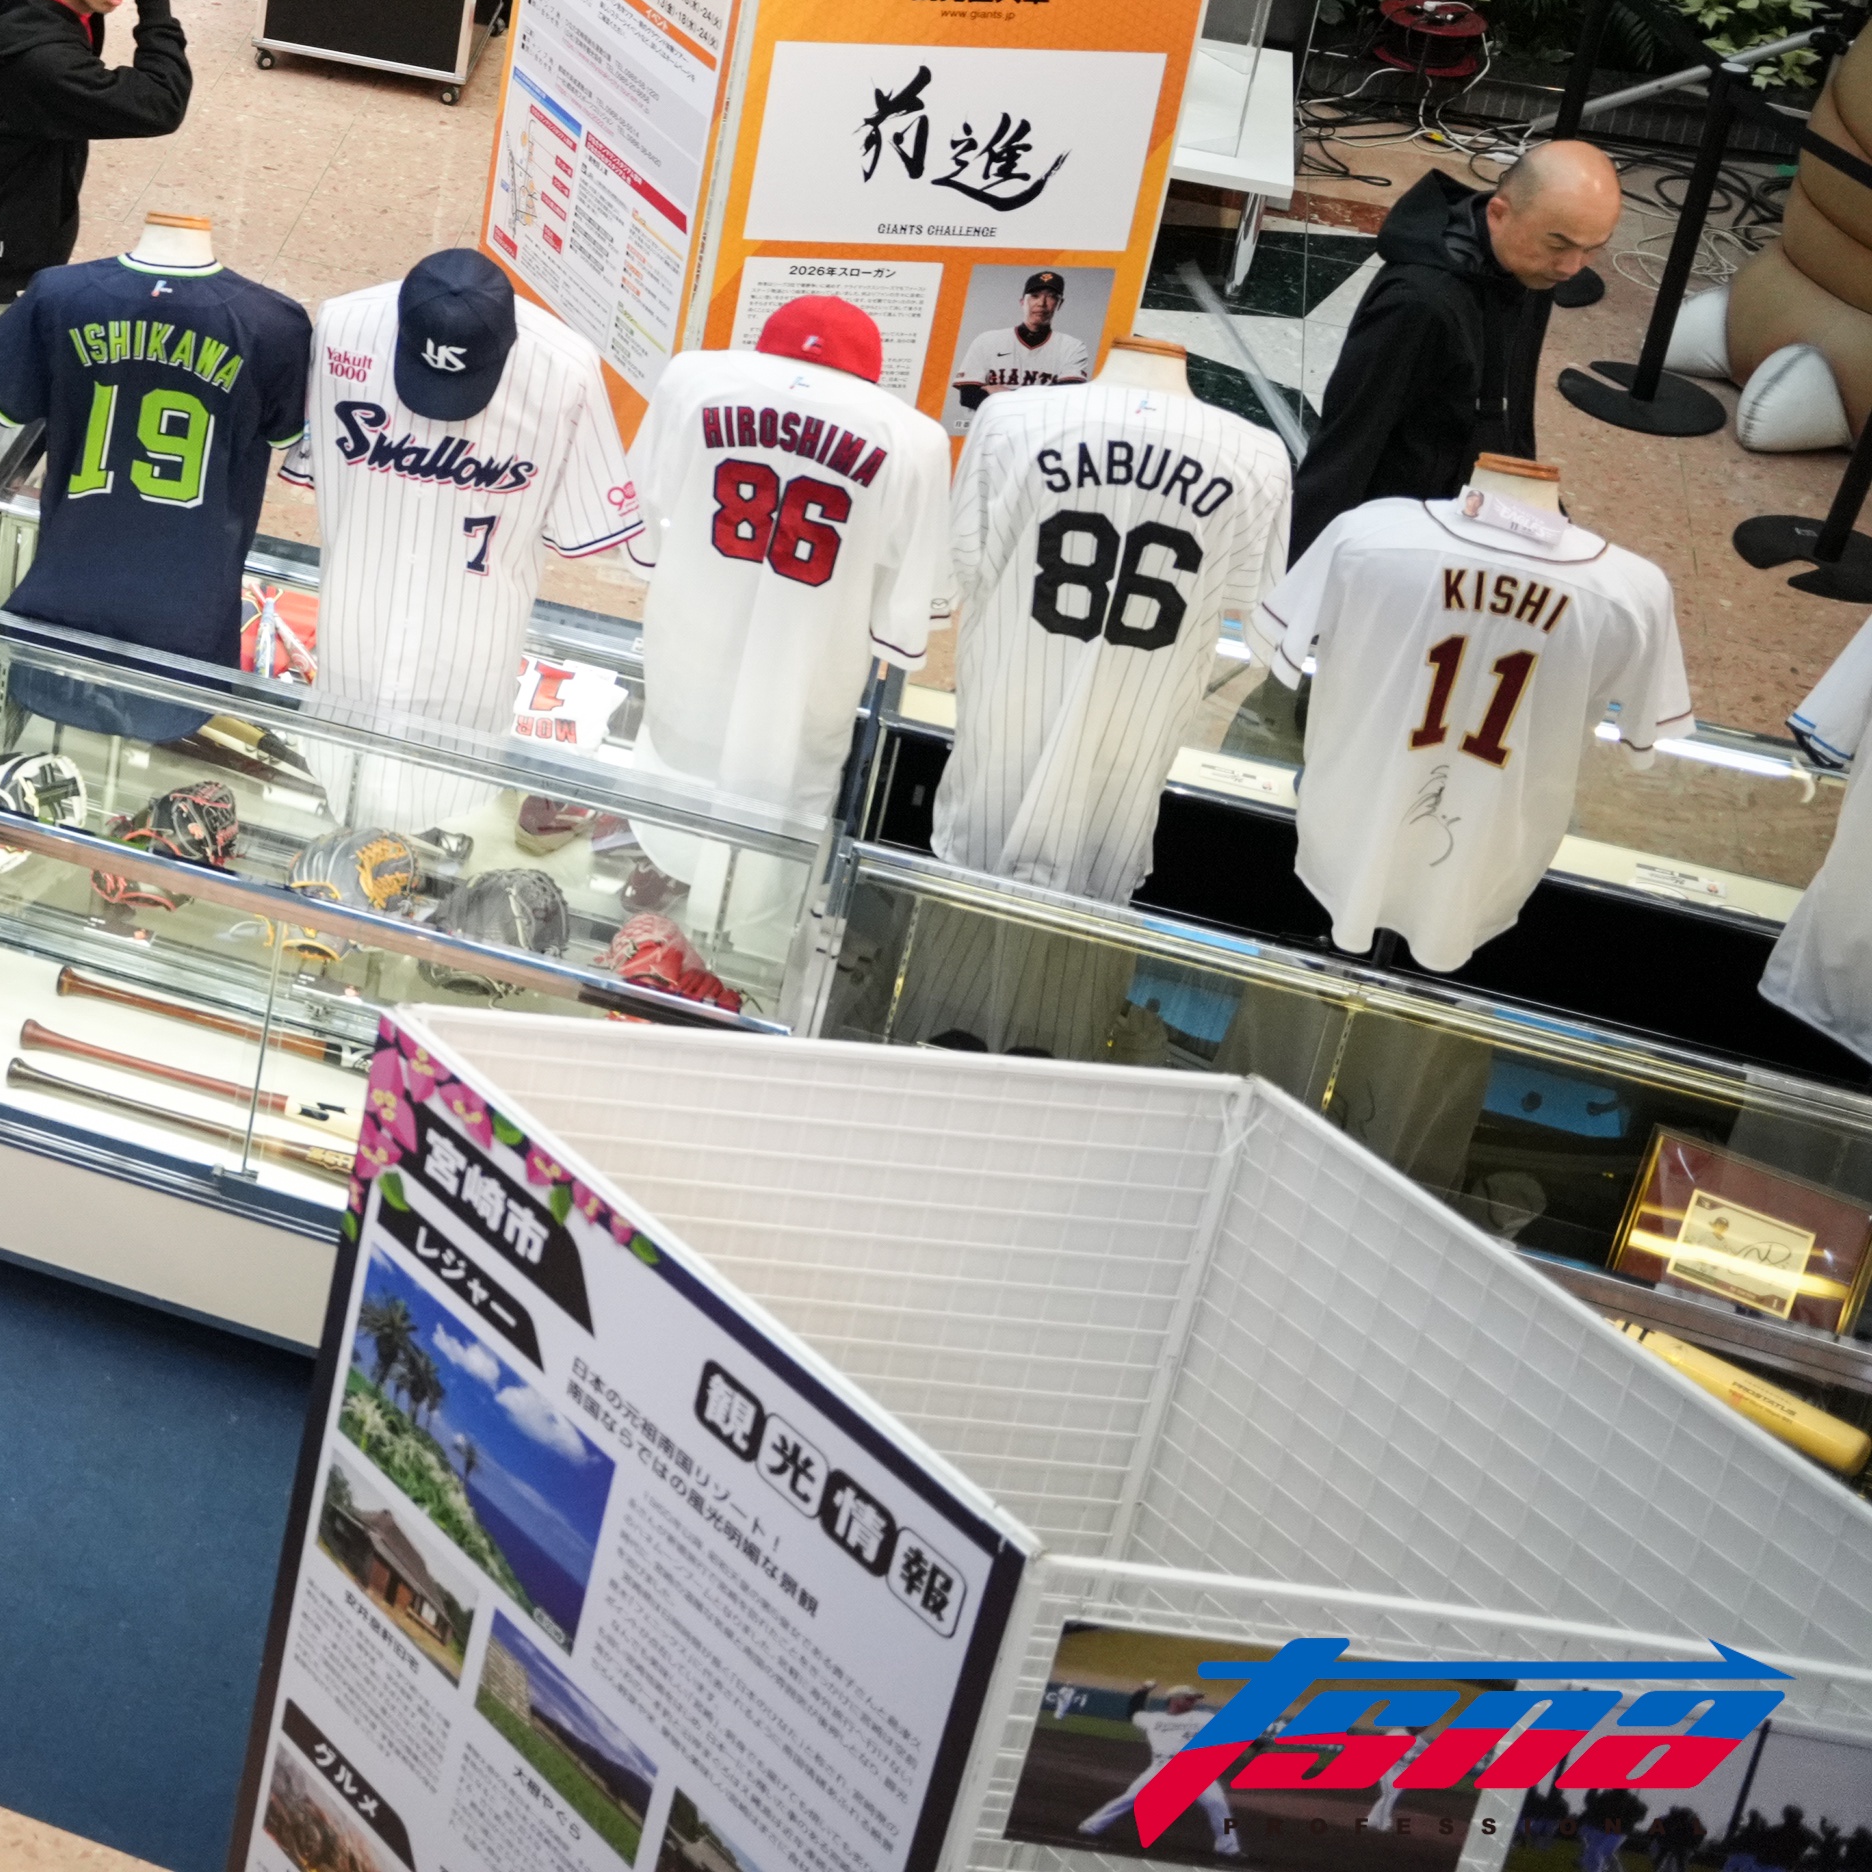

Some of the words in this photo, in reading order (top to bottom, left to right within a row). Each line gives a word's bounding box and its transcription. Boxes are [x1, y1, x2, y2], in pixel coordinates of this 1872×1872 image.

[940, 8, 1016, 21] www.giants.jp
[851, 59, 1073, 213] 前進
[789, 265, 897, 279] 2026年スローガン
[877, 223, 924, 236] GIANTS
[927, 224, 998, 238] CHALLENGE
[66, 314, 245, 395] ISHIKAWA
[326, 343, 374, 371] Yakult
[326, 360, 370, 385] 1000
[66, 380, 216, 510] 19
[332, 399, 538, 494] Swallows
[702, 404, 889, 489] HIROSHIMA
[1037, 439, 1234, 520] SABURO
[464, 513, 497, 575] 7
[710, 457, 854, 589] 86
[1031, 508, 1205, 653] 86
[1441, 566, 1571, 635] KISHI
[1408, 633, 1539, 770] 11
[424, 1127, 550, 1265] 宮崎市
[415, 1225, 517, 1328] レジャー
[566, 1380, 821, 1618] 南国ならではの風光明媚な景観
[571, 1356, 783, 1555] 日本の元祖南国リゾート！
[699, 1368, 956, 1628] 観光情報
[312, 1742, 380, 1821] グルメ
